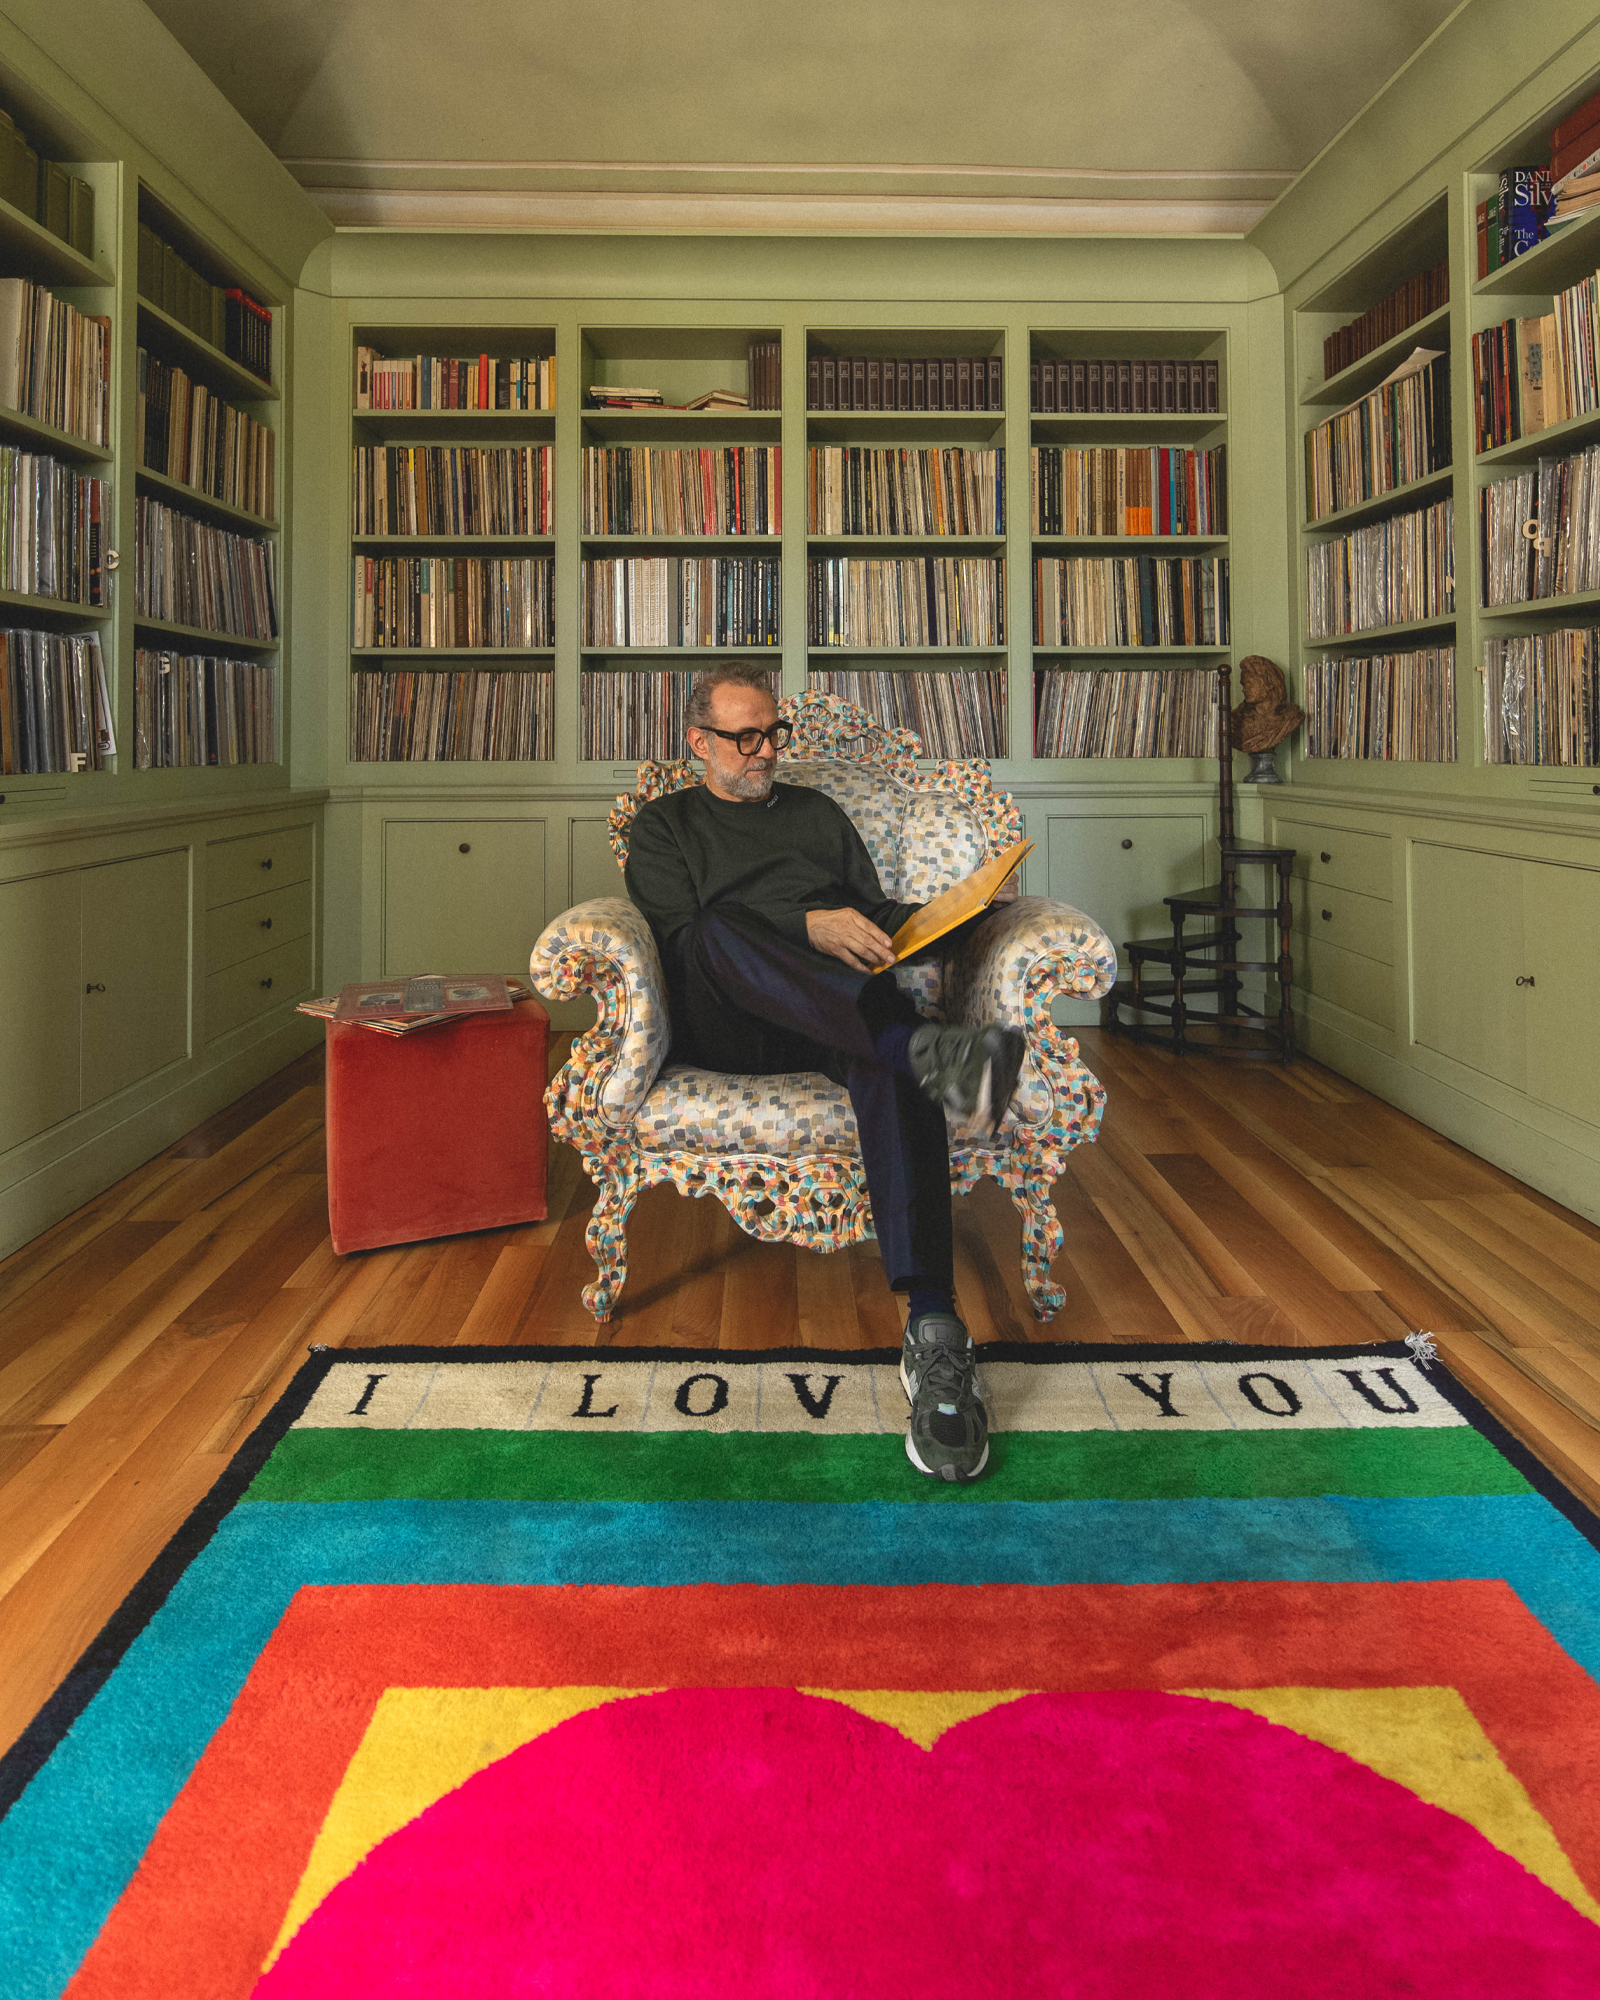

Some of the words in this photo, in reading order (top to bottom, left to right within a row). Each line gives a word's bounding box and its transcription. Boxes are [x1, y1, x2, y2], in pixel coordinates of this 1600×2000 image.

[1514, 170, 1551, 183] DANI
[1514, 228, 1534, 239] The
[104, 550, 120, 570] C
[70, 753, 87, 773] F
[344, 1373, 387, 1416] I
[570, 1373, 912, 1420] LOV
[1117, 1366, 1420, 1418] YOU
